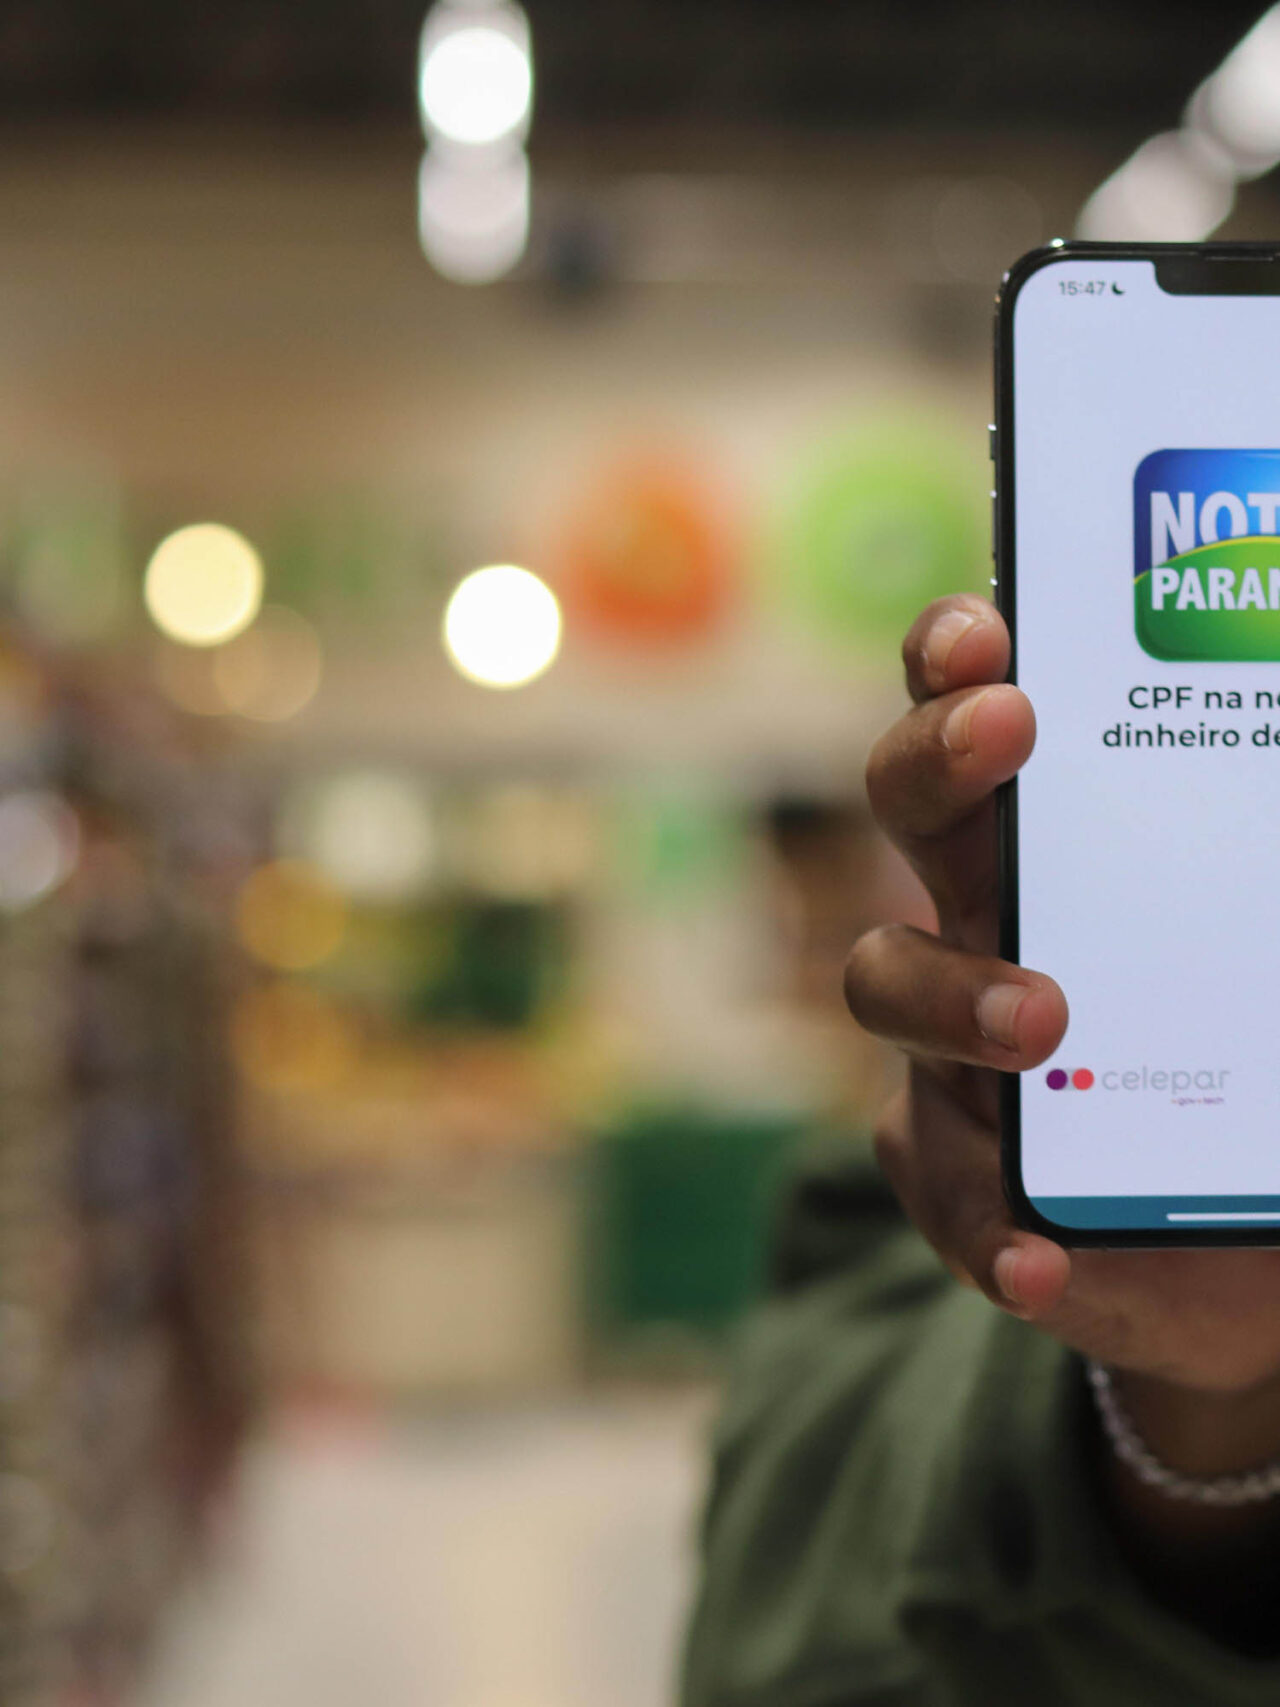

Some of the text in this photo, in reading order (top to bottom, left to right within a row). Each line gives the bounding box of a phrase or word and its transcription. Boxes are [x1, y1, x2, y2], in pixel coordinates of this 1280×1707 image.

[1059, 281, 1105, 296] 15:47
[1128, 686, 1193, 709] CPF
[1204, 690, 1242, 709] na
[1102, 722, 1241, 747] dinheiro
[1101, 1065, 1230, 1095] celepar
